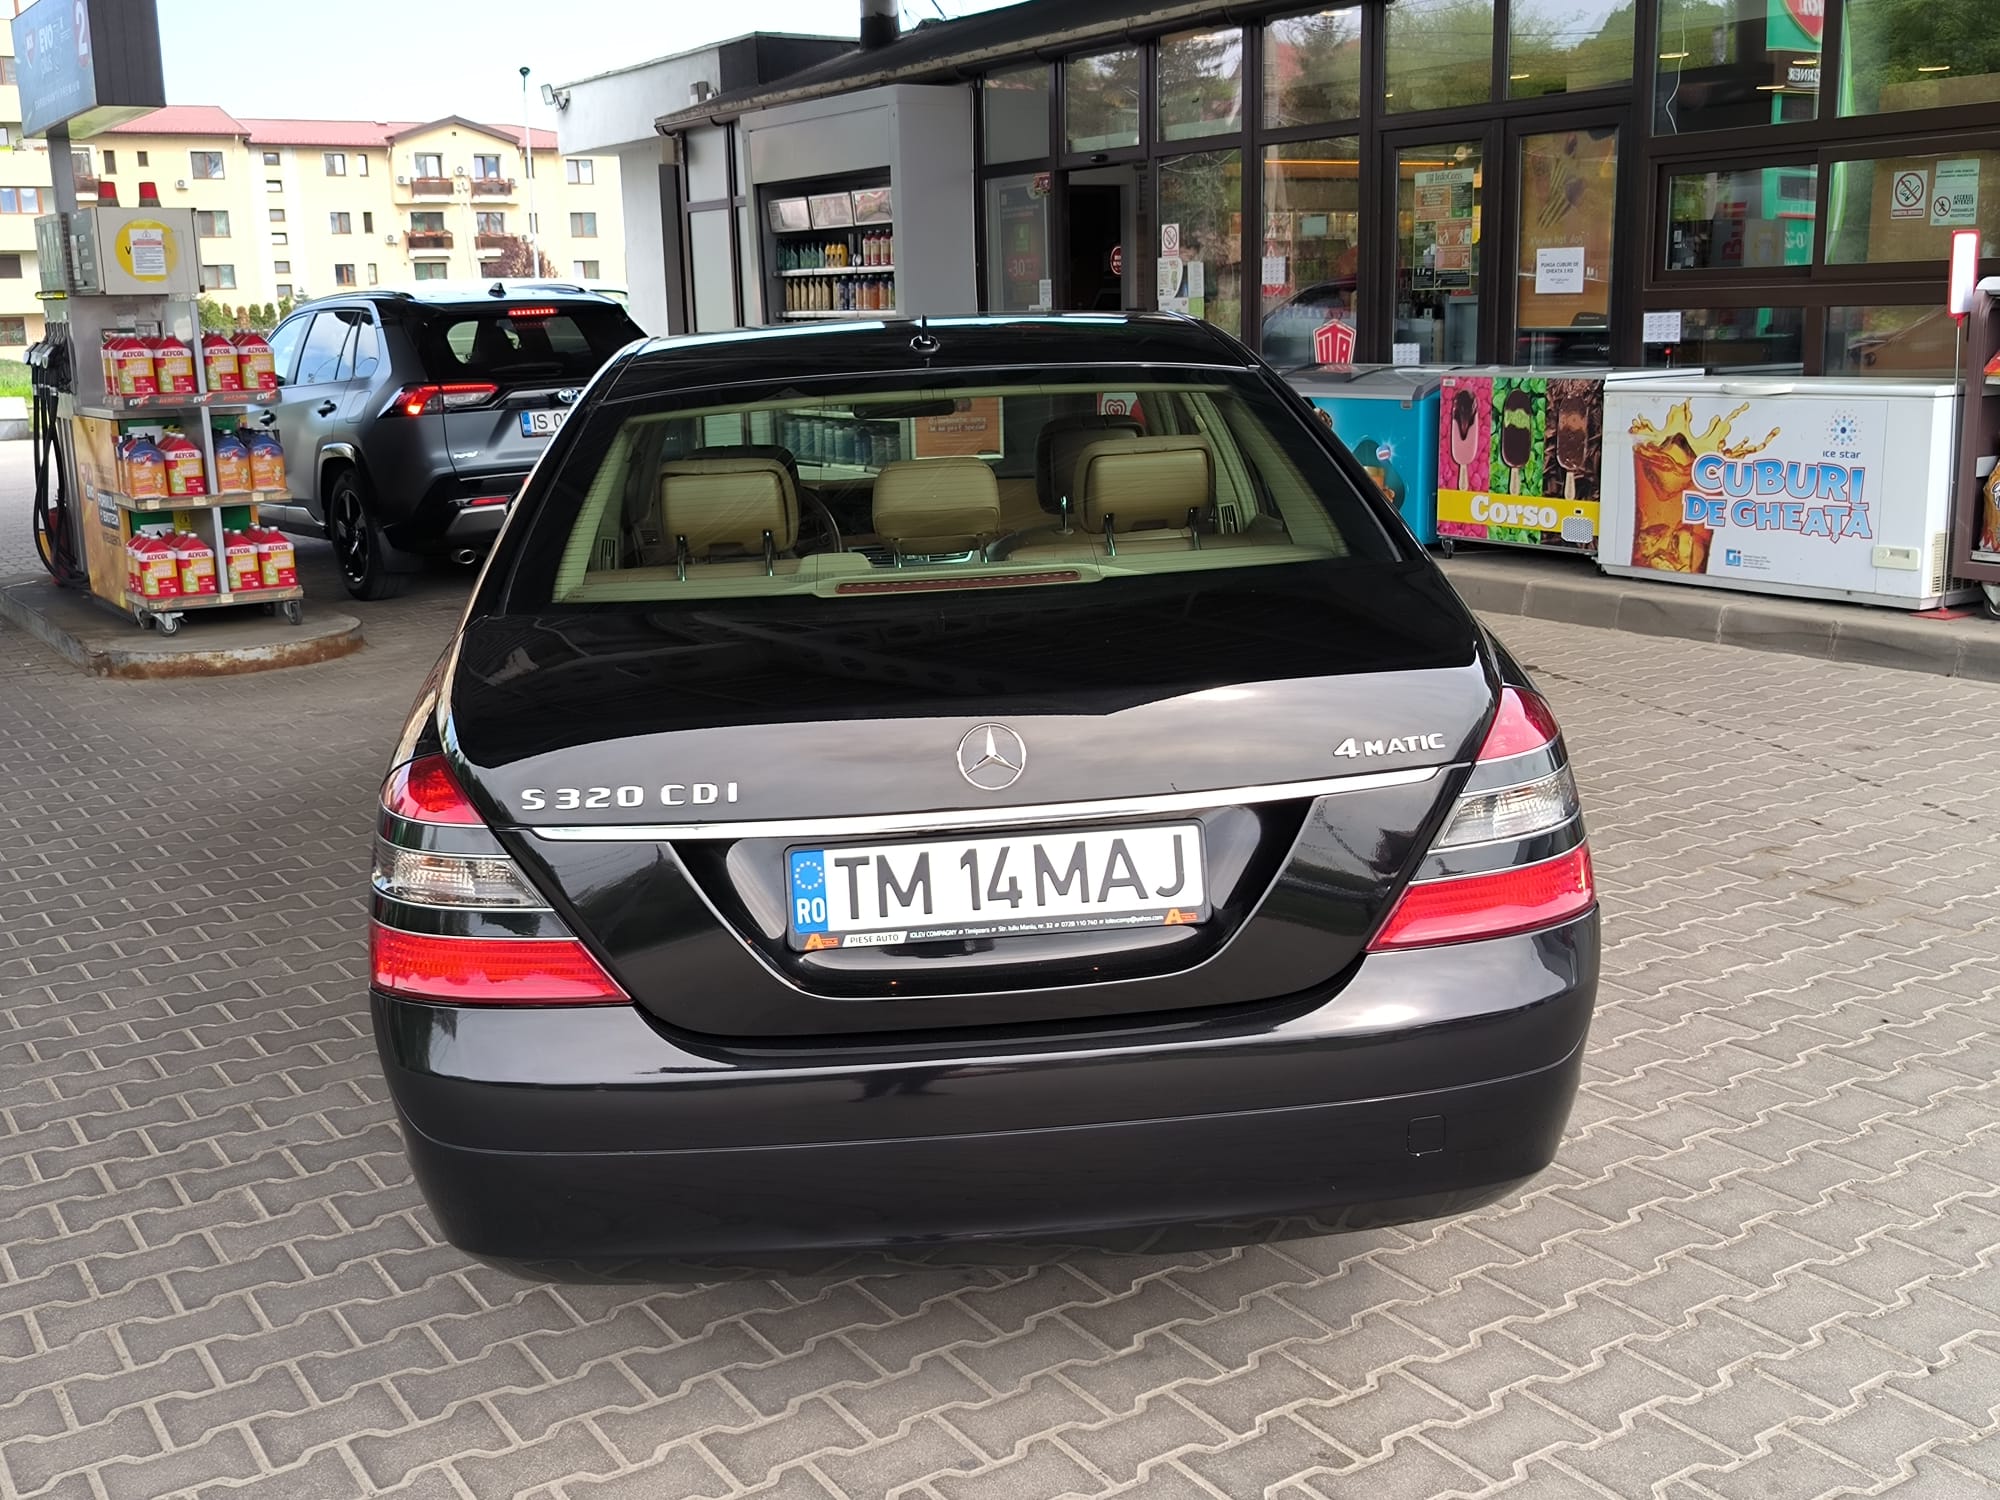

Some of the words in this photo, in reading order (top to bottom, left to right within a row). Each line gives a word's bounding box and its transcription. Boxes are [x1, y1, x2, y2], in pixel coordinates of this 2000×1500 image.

[75, 1, 88, 56] 2
[532, 414, 548, 430] IS
[1822, 450, 1836, 458] ice
[1839, 450, 1861, 459] star
[1694, 454, 1866, 503] CUBURI
[1470, 494, 1558, 529] Corso
[1684, 493, 1727, 527] DE
[660, 782, 738, 806] CDI
[834, 852, 933, 919] TM
[797, 898, 826, 924] RO
[850, 935, 874, 944] PIESE
[876, 934, 899, 942] AUTO
